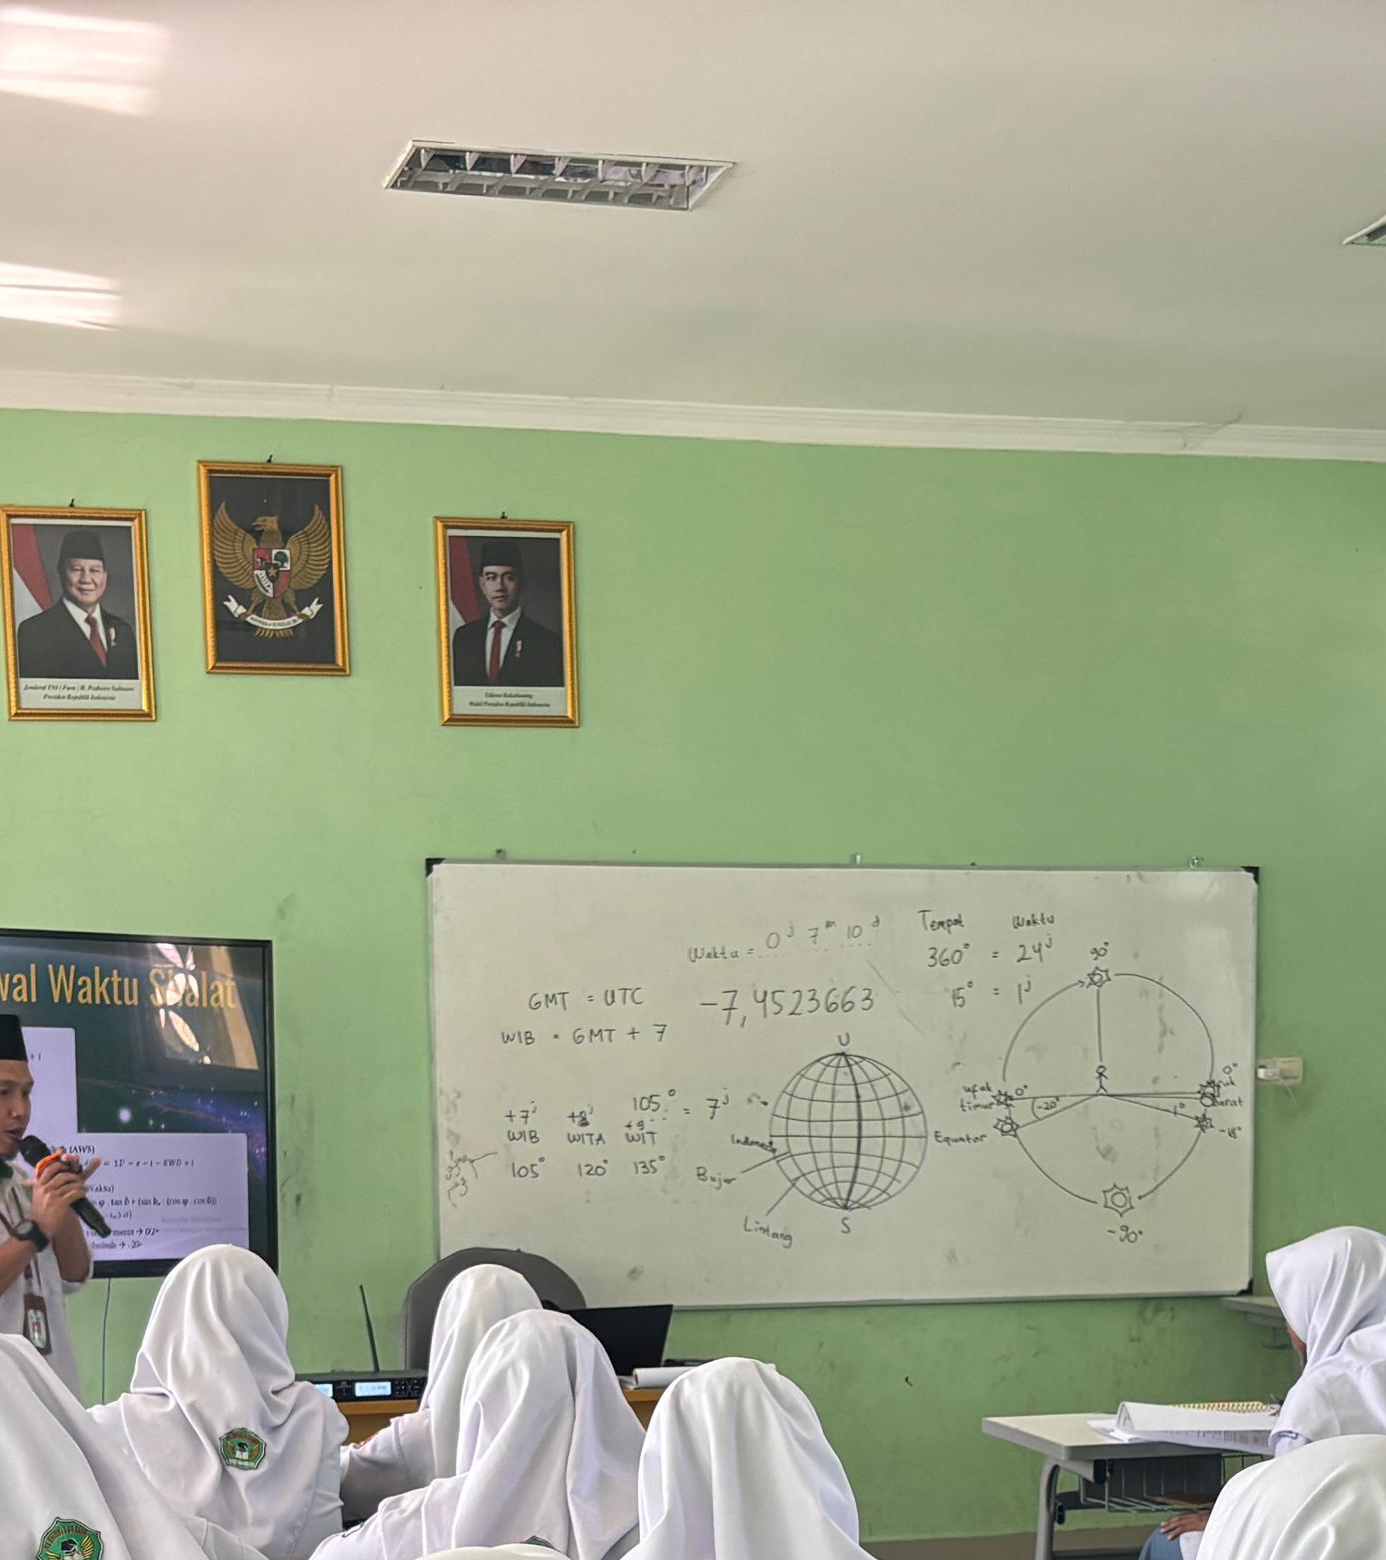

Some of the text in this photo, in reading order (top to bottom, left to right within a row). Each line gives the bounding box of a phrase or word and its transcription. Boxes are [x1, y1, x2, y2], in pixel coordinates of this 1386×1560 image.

[917, 909, 1055, 934] Tempat Waktu
[688, 946, 740, 963] Waktu
[48, 964, 139, 1007] Waktu
[528, 991, 570, 1011] GMT
[603, 987, 645, 1006] UTC
[501, 1030, 536, 1045] WIB
[572, 1027, 617, 1045] GMT
[652, 1023, 668, 1042] 7
[837, 1032, 851, 1047] U
[507, 1129, 659, 1145] WIB WITA WIT
[933, 1131, 988, 1145] Equator
[743, 1215, 793, 1249] Lintang
[840, 1217, 852, 1234] S
